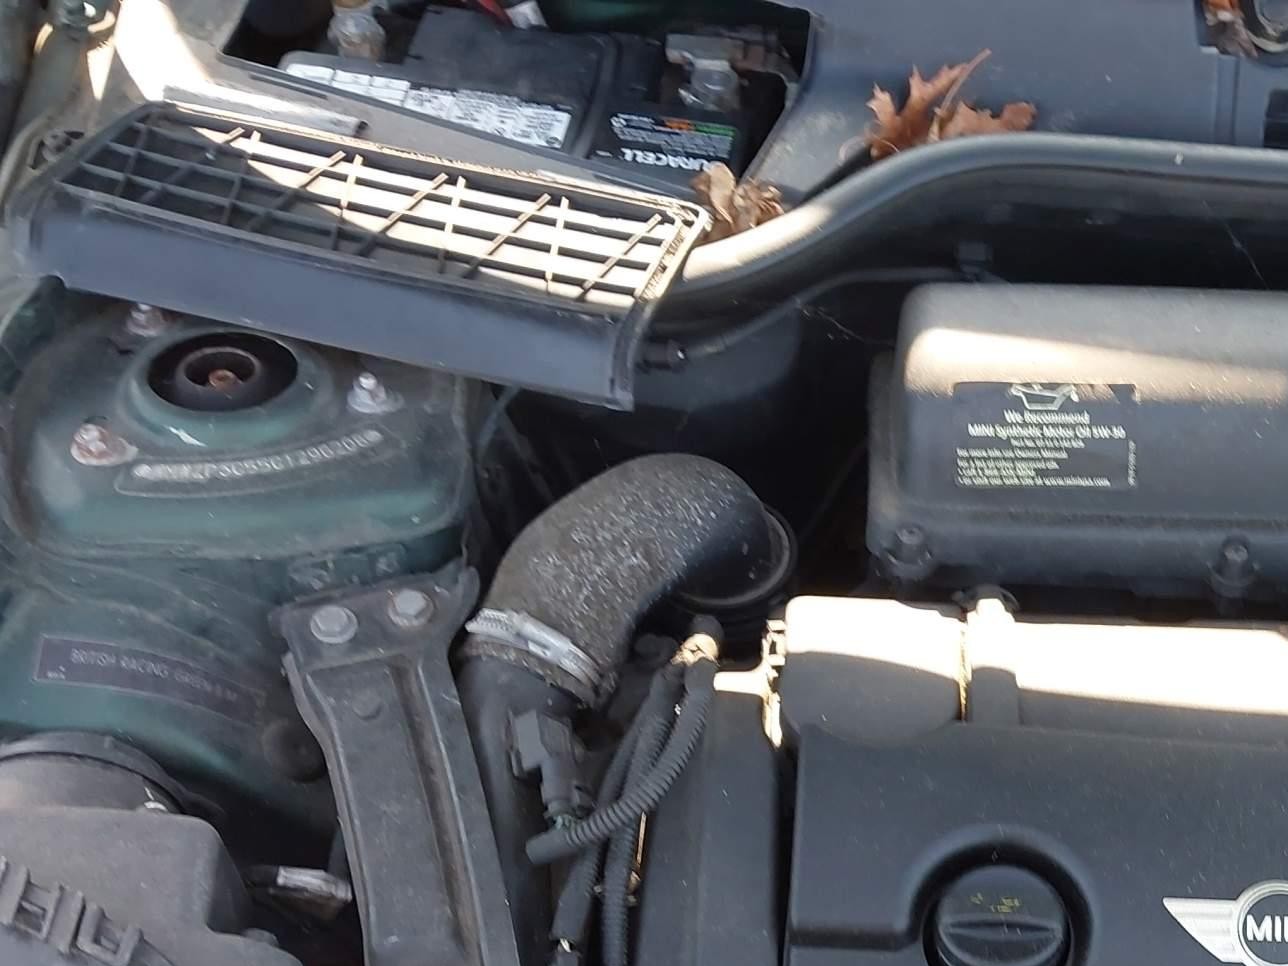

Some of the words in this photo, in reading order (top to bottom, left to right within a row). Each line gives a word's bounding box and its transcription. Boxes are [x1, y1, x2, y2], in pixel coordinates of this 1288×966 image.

[621, 148, 713, 171] URACELL
[1024, 411, 1090, 424] Recommend
[968, 424, 995, 437] MINI
[995, 424, 1042, 440] Synthetic
[1043, 425, 1074, 438] Motor
[1075, 425, 1091, 438] Oil
